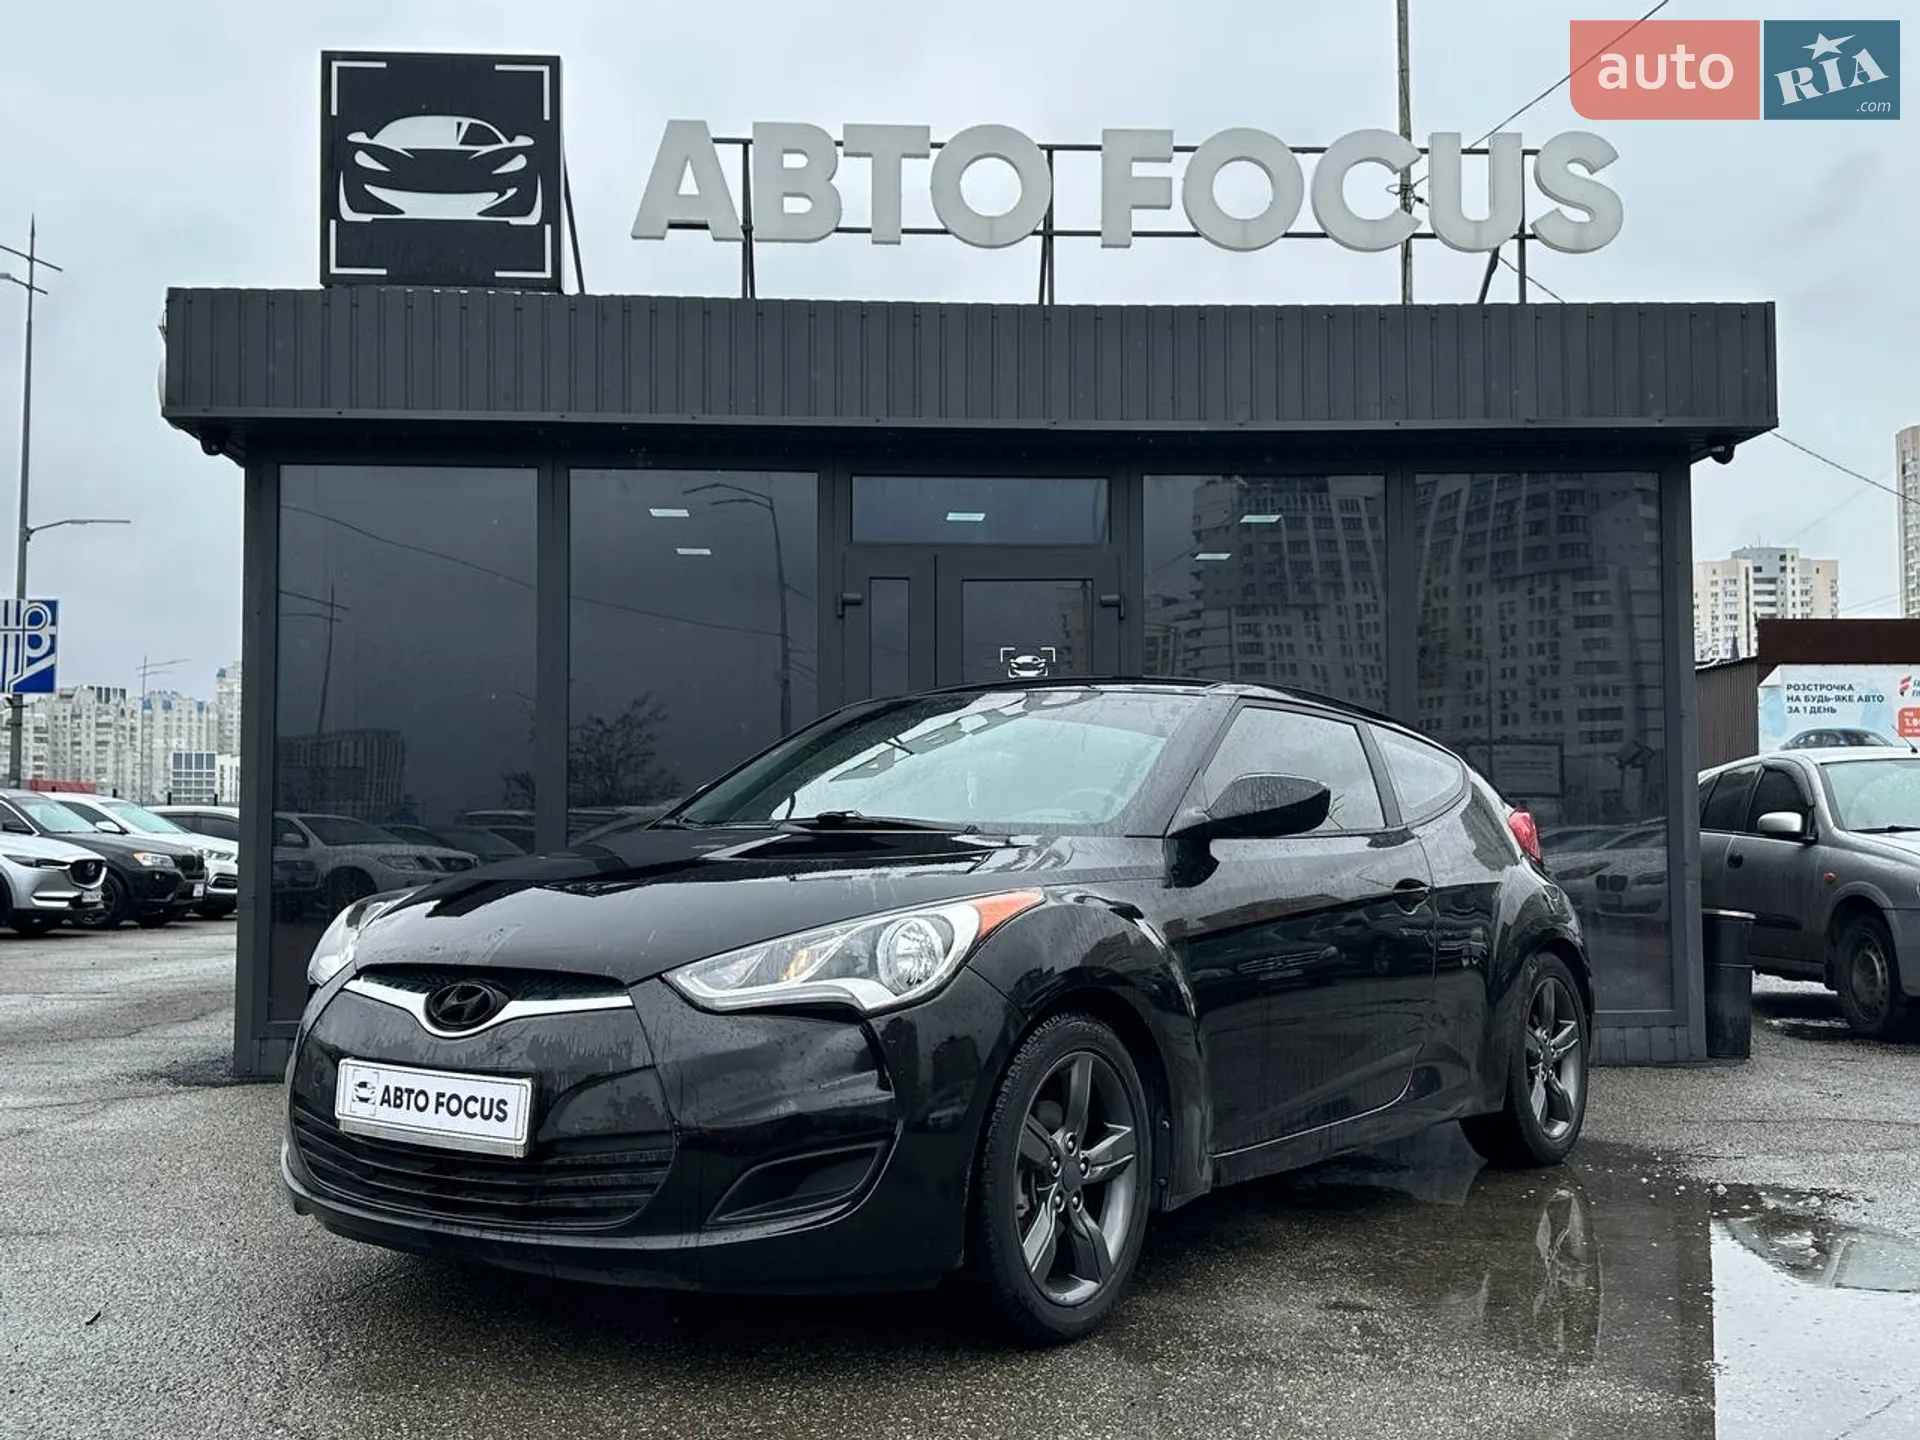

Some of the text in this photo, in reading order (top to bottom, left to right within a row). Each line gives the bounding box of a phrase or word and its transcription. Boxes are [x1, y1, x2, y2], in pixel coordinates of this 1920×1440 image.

[631, 119, 1624, 253] АВТО FOCUS
[1786, 683, 1854, 692] РОЗСТРОЧКА
[1786, 695, 1885, 704] НА БУДЬ-ЯКЕ АВТО
[1787, 706, 1837, 715] ЗА 1 ДЕНЬ
[380, 1085, 508, 1122] АВТО FOCUS
